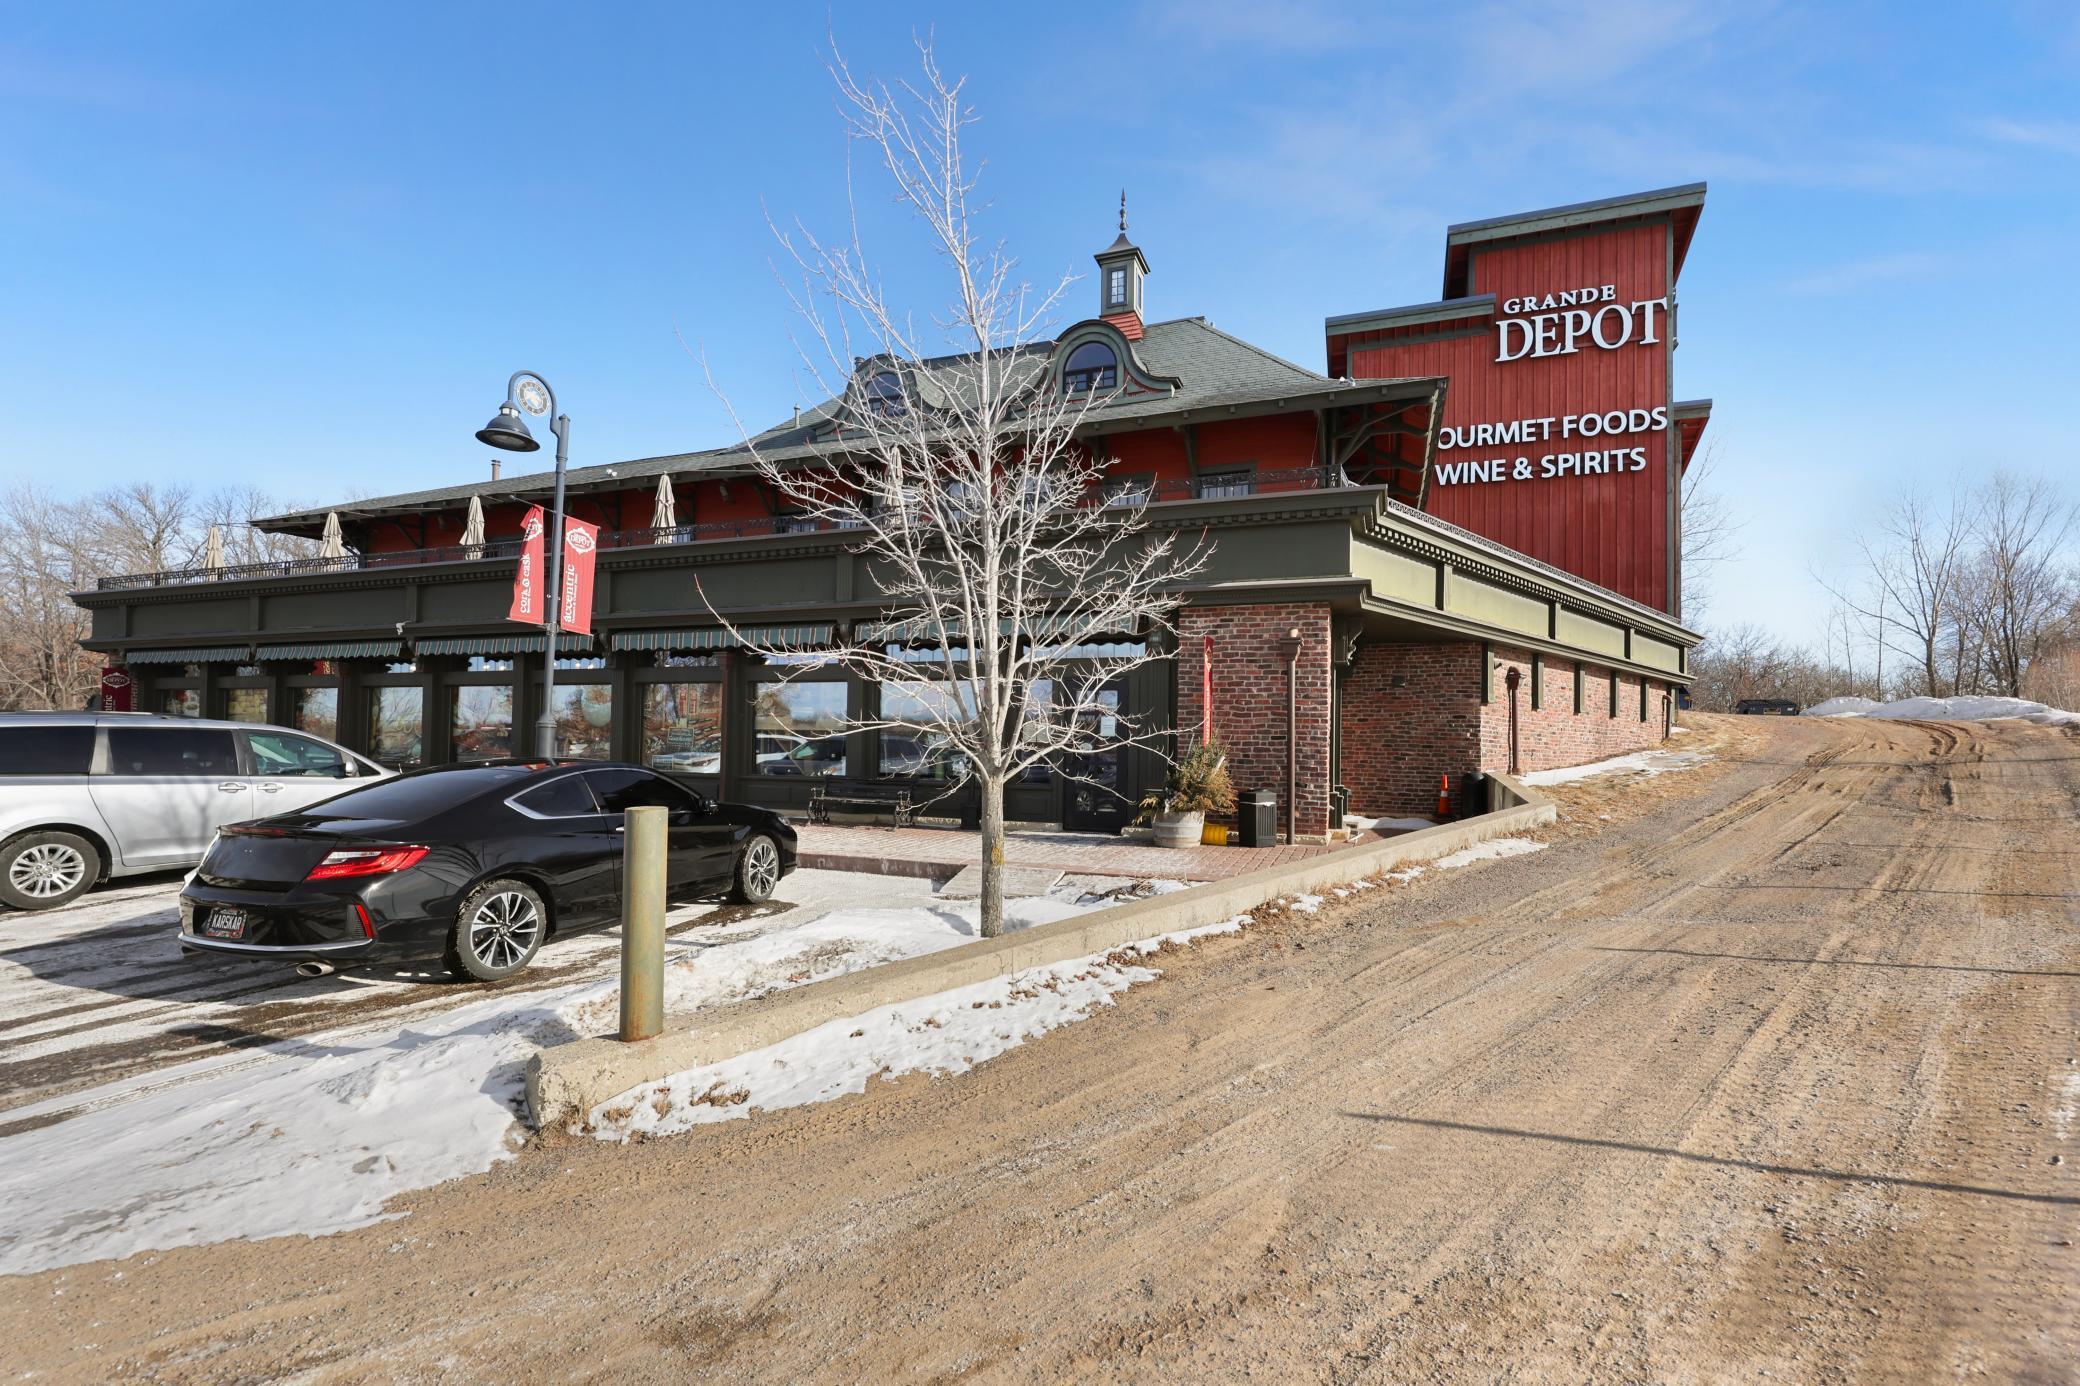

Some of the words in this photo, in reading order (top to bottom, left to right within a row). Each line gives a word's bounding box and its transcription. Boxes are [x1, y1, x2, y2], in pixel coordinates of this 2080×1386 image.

[1503, 284, 1617, 314] GRANDE
[1495, 296, 1668, 363] DEPOT
[1438, 417, 1556, 450] OURMET
[1562, 406, 1668, 439] FOODS
[1435, 459, 1506, 486] WINE
[1512, 457, 1533, 480] &
[1540, 447, 1647, 479] SPIRITS
[211, 914, 243, 930] KARSKAR
